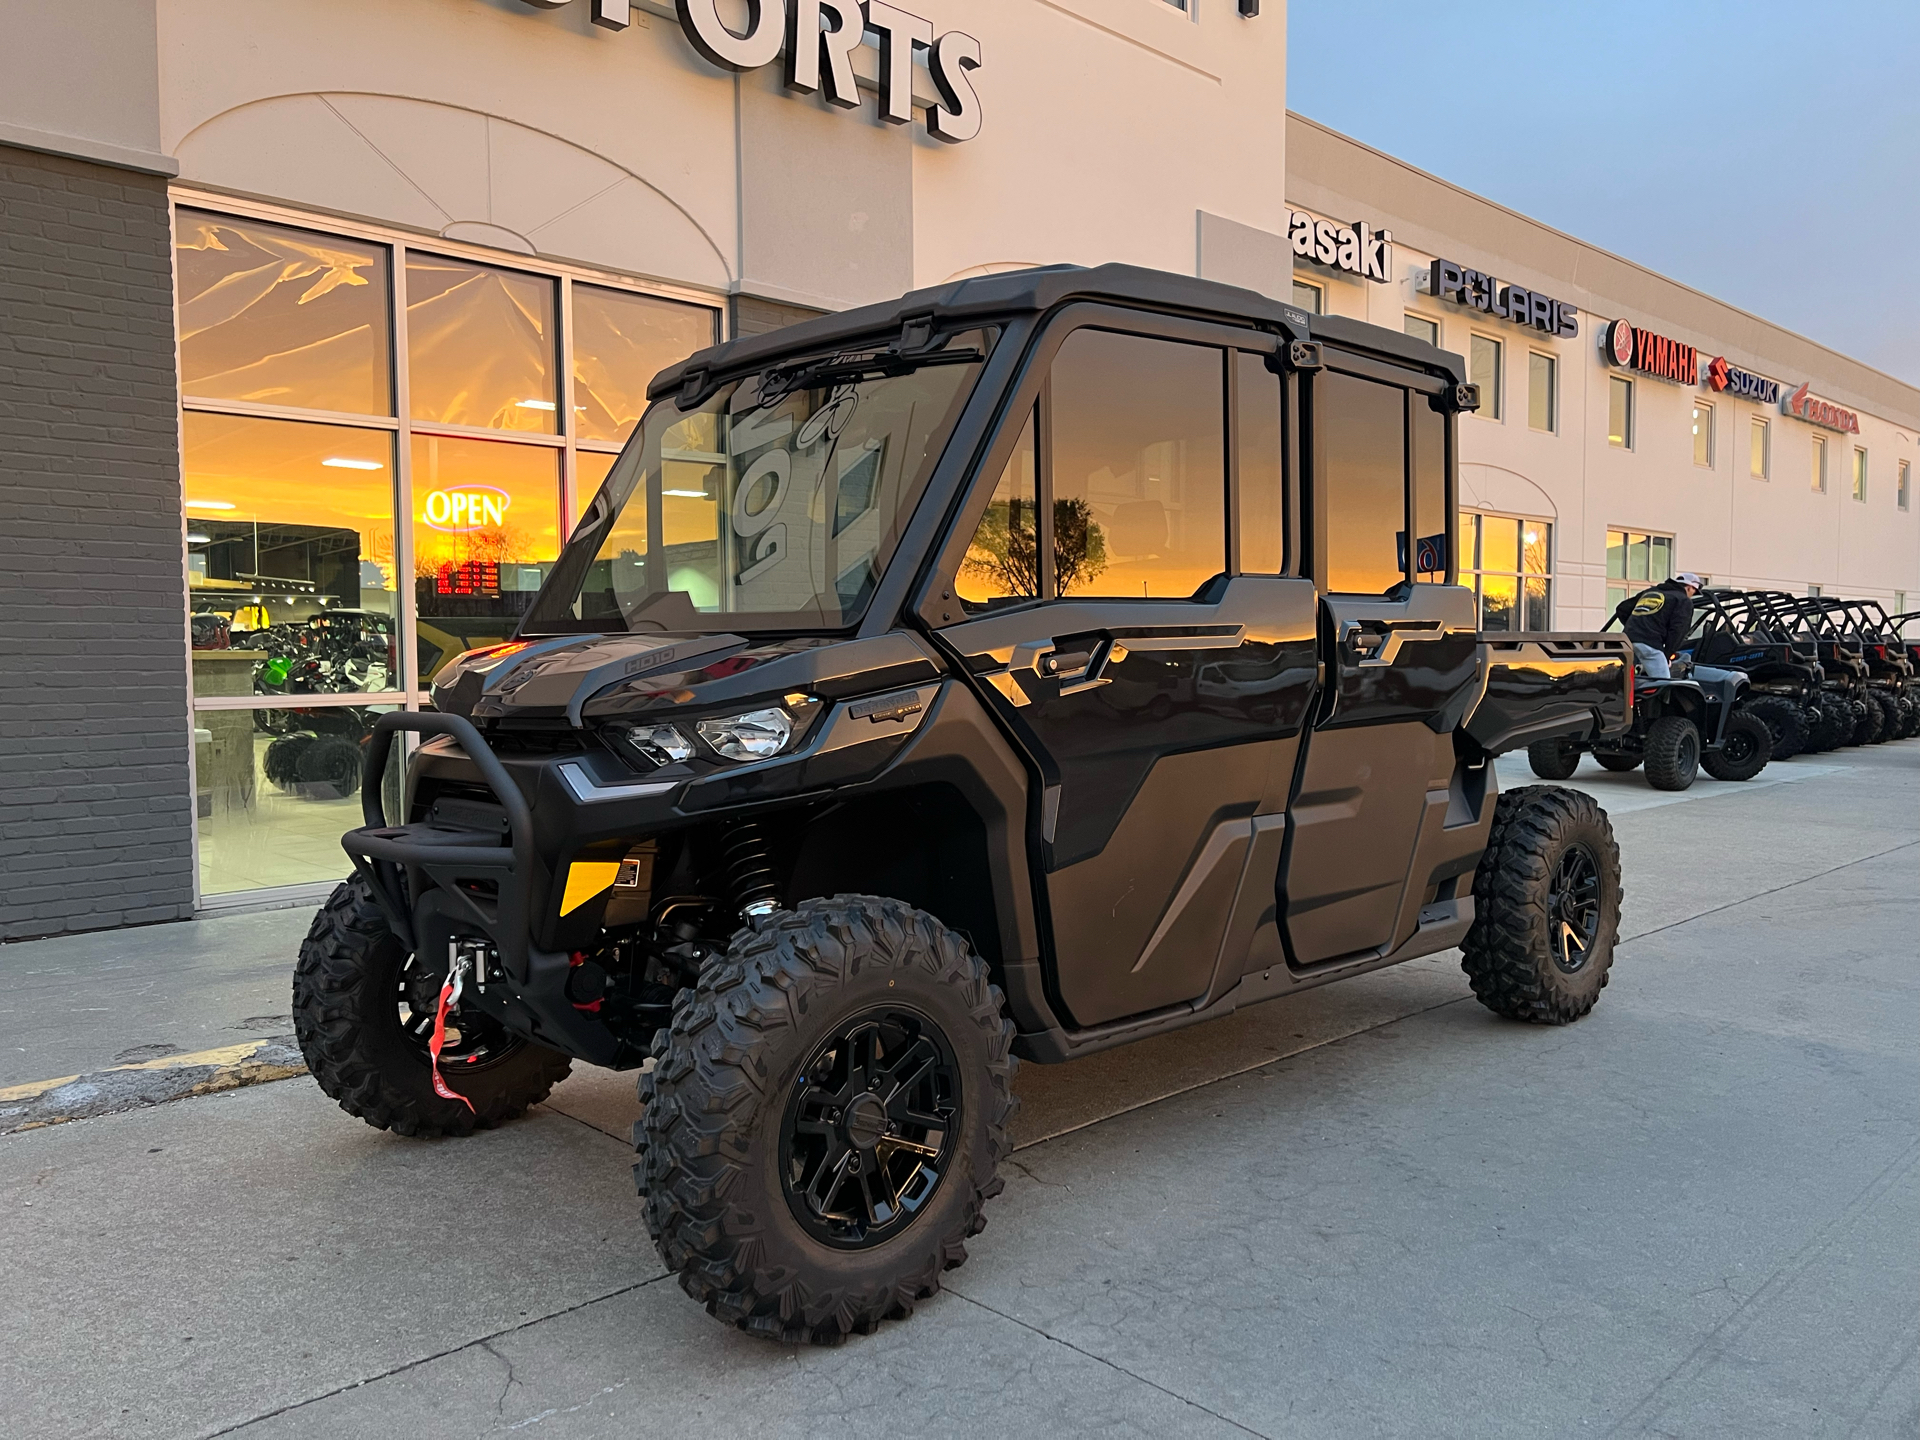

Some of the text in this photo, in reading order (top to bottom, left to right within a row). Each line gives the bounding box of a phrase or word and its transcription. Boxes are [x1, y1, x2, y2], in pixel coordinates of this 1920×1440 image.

[522, 0, 982, 144] ORTS
[1432, 258, 1579, 339] POLARIS
[1634, 327, 1698, 386] YAMAHA
[1730, 367, 1780, 404] SUZUKI
[1808, 397, 1860, 435] HONDA
[426, 490, 503, 527] OPEN
[626, 649, 674, 674] HD10
[1729, 651, 1764, 664] can-am
